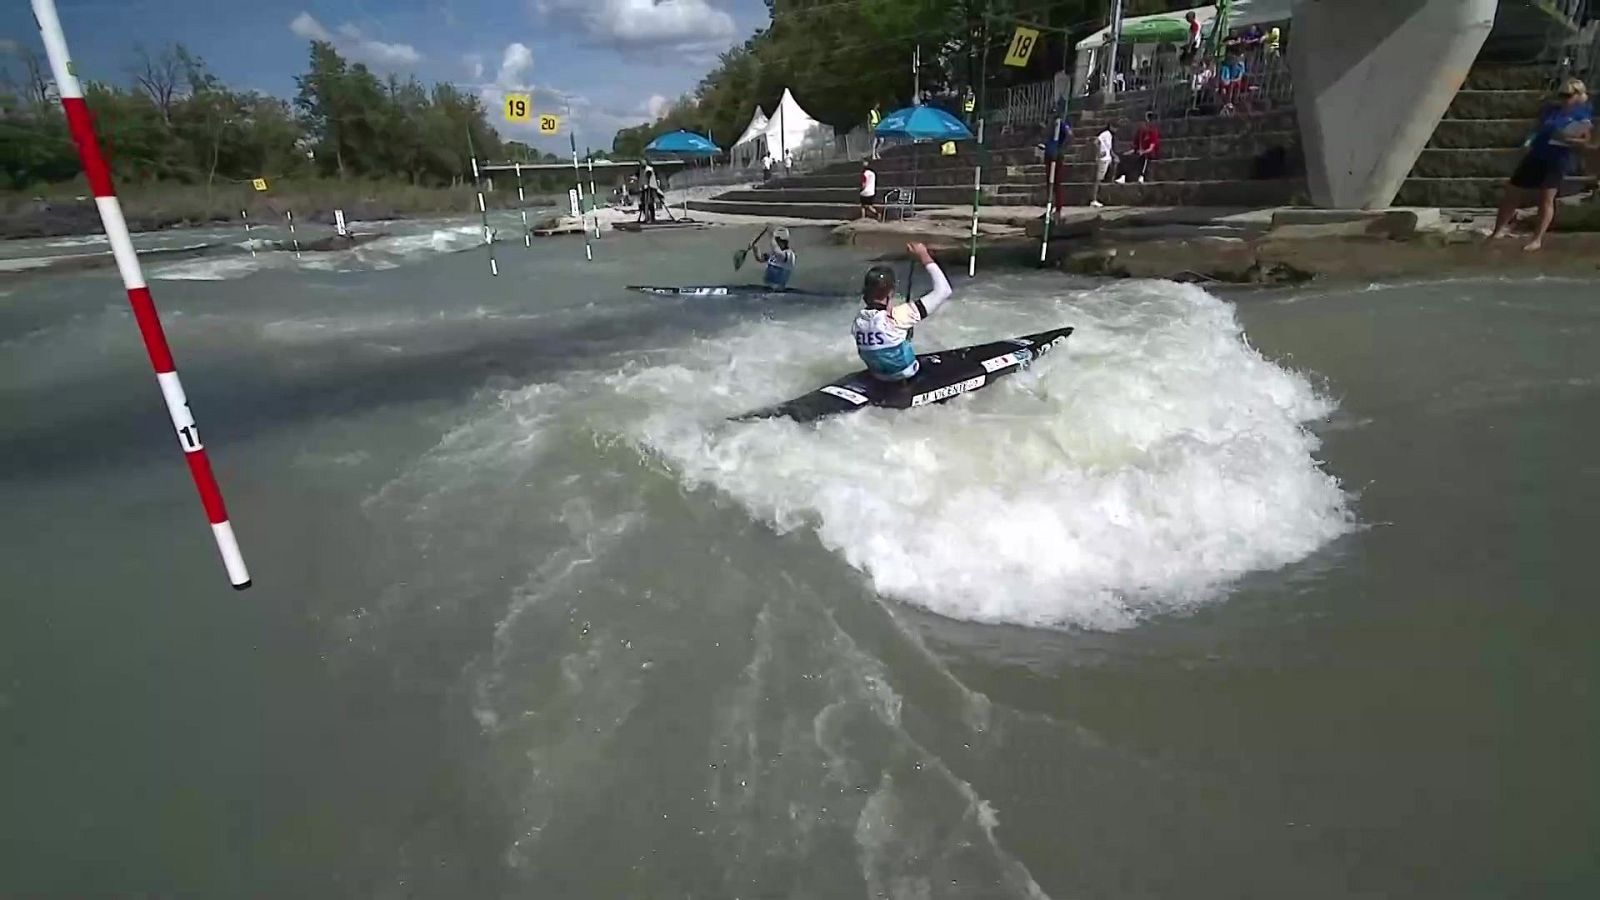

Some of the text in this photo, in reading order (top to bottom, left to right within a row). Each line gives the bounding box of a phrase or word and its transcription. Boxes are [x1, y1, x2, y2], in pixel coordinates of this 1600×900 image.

[1012, 35, 1032, 58] 18
[509, 100, 525, 117] 19
[541, 118, 556, 131] 20
